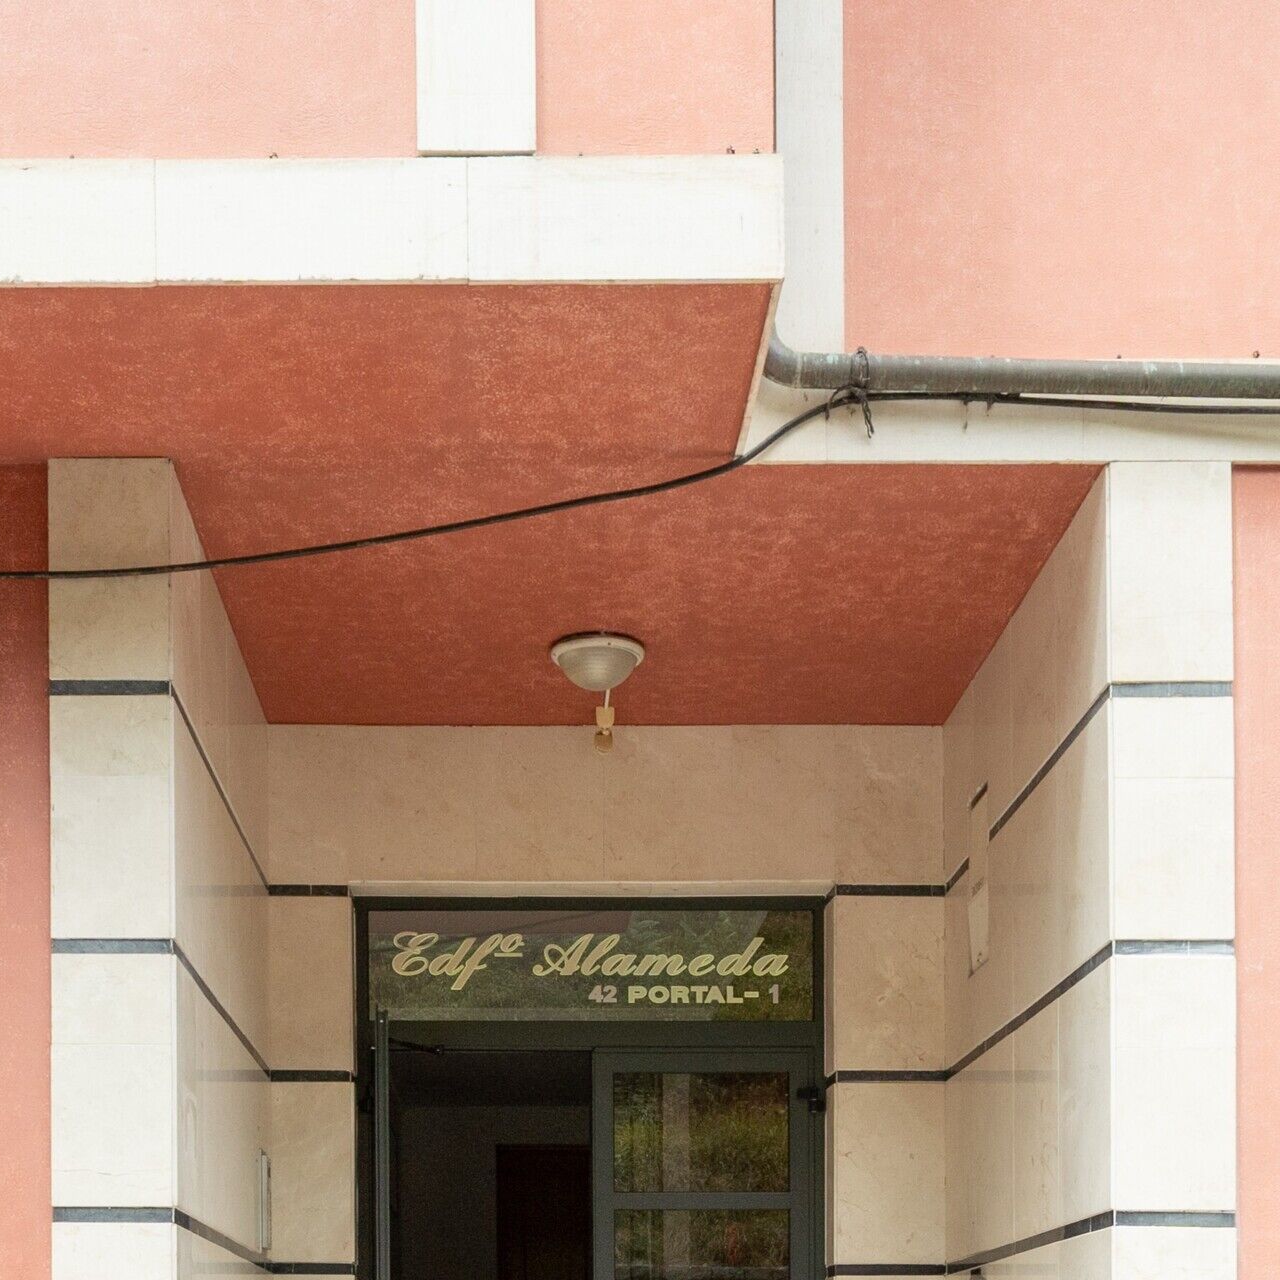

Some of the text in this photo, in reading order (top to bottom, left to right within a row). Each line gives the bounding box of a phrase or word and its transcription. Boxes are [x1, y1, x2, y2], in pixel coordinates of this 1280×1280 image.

[532, 932, 790, 977] Alameda
[588, 985, 618, 1004] 42
[768, 985, 781, 1004] 1
